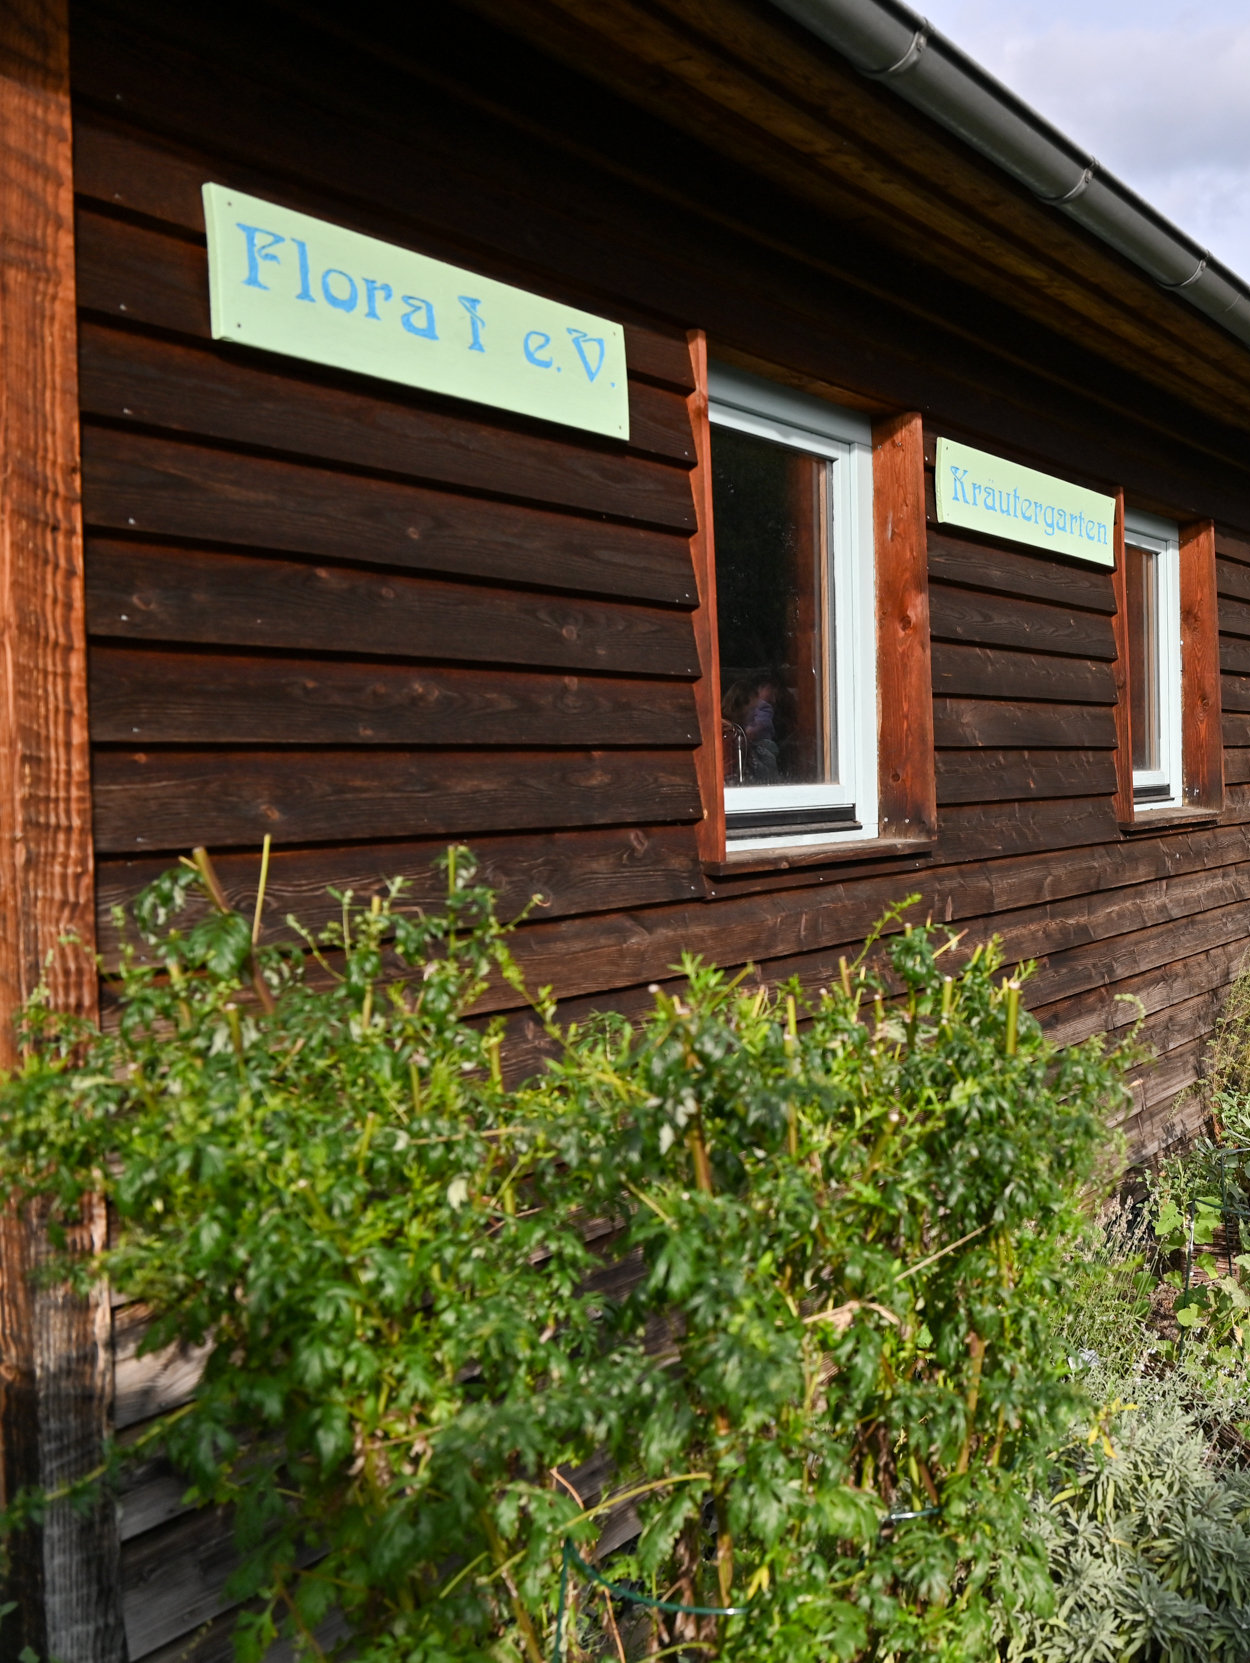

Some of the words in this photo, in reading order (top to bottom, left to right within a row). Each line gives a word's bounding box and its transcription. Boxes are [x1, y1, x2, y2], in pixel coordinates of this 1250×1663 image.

[236, 222, 439, 342] Flora
[523, 327, 617, 388] e.V.
[949, 465, 1108, 545] Kräutergarten
